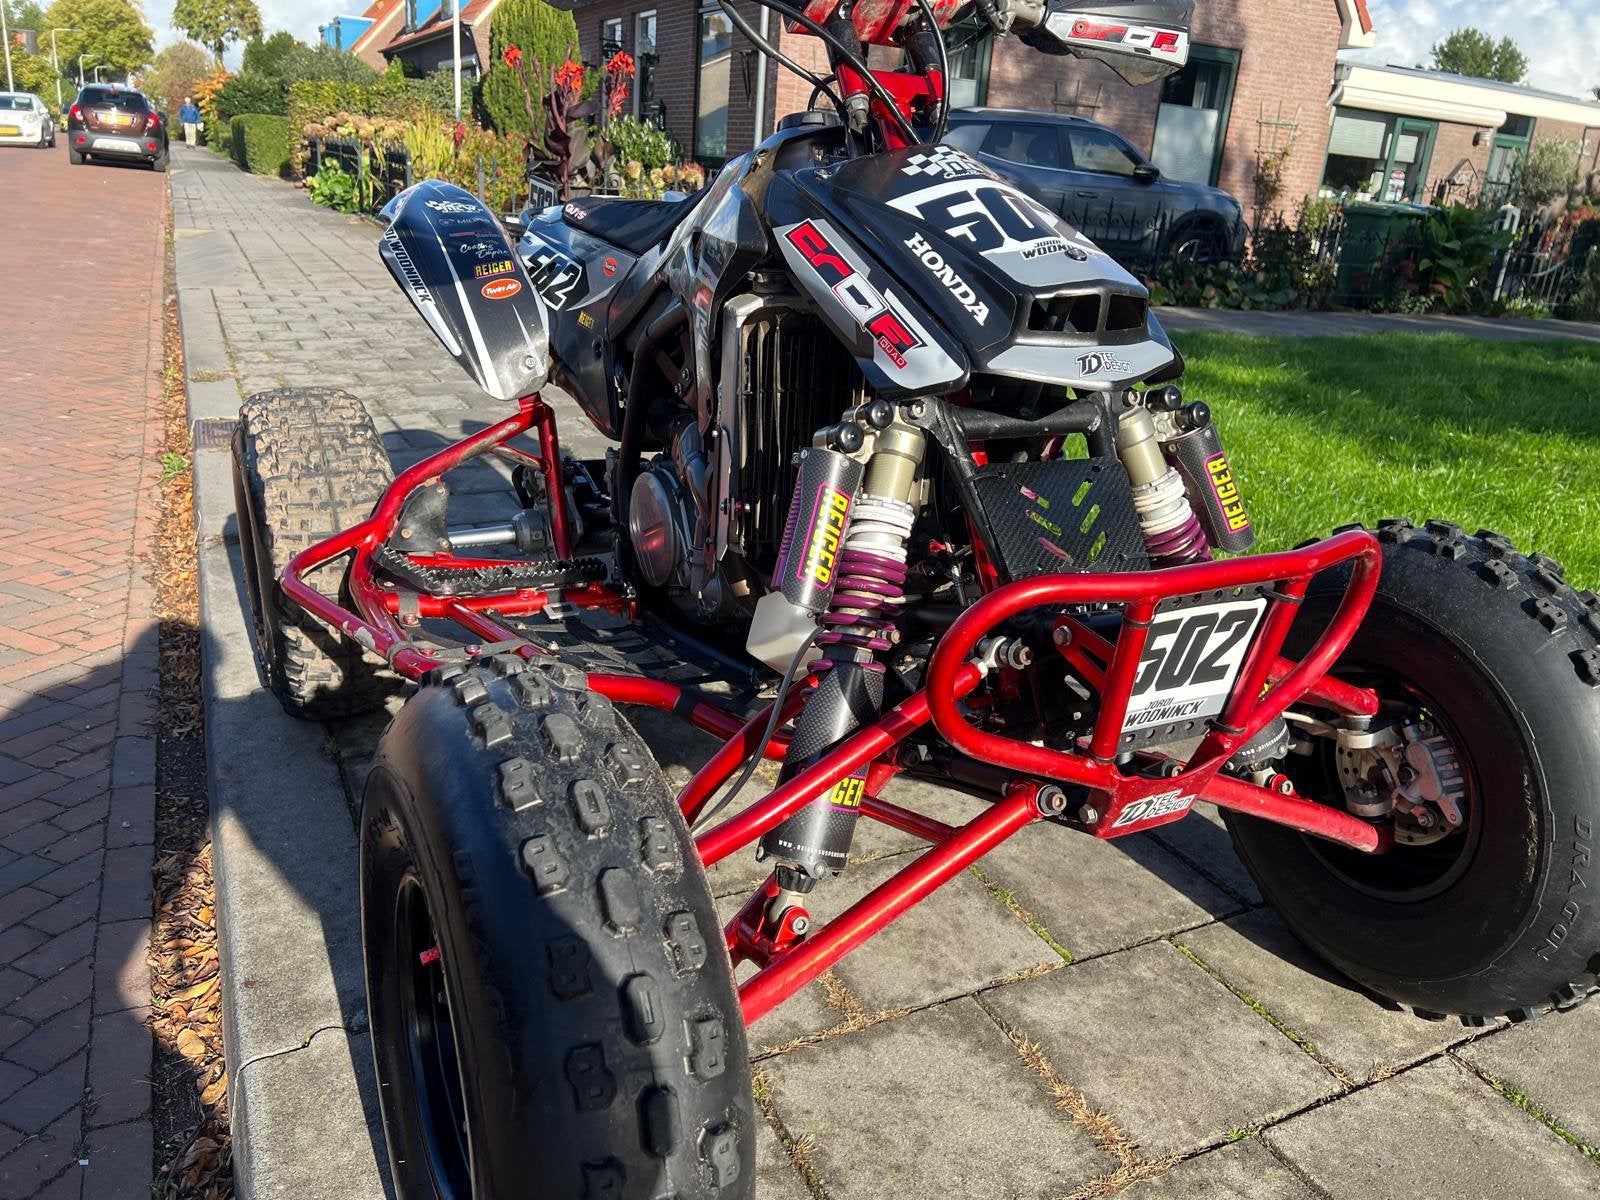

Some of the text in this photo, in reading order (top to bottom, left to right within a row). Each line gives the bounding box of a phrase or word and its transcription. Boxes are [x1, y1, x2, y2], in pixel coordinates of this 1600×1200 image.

[565, 203, 587, 220] GUTS
[475, 260, 513, 277] REIGER
[904, 231, 990, 327] HONDA
[880, 337, 905, 367] QUAD
[1207, 457, 1249, 532] REIGER
[805, 487, 849, 585] REIGER
[1131, 608, 1259, 696] 502
[1124, 700, 1205, 728] WOONINCK
[1144, 697, 1175, 711] JORDI
